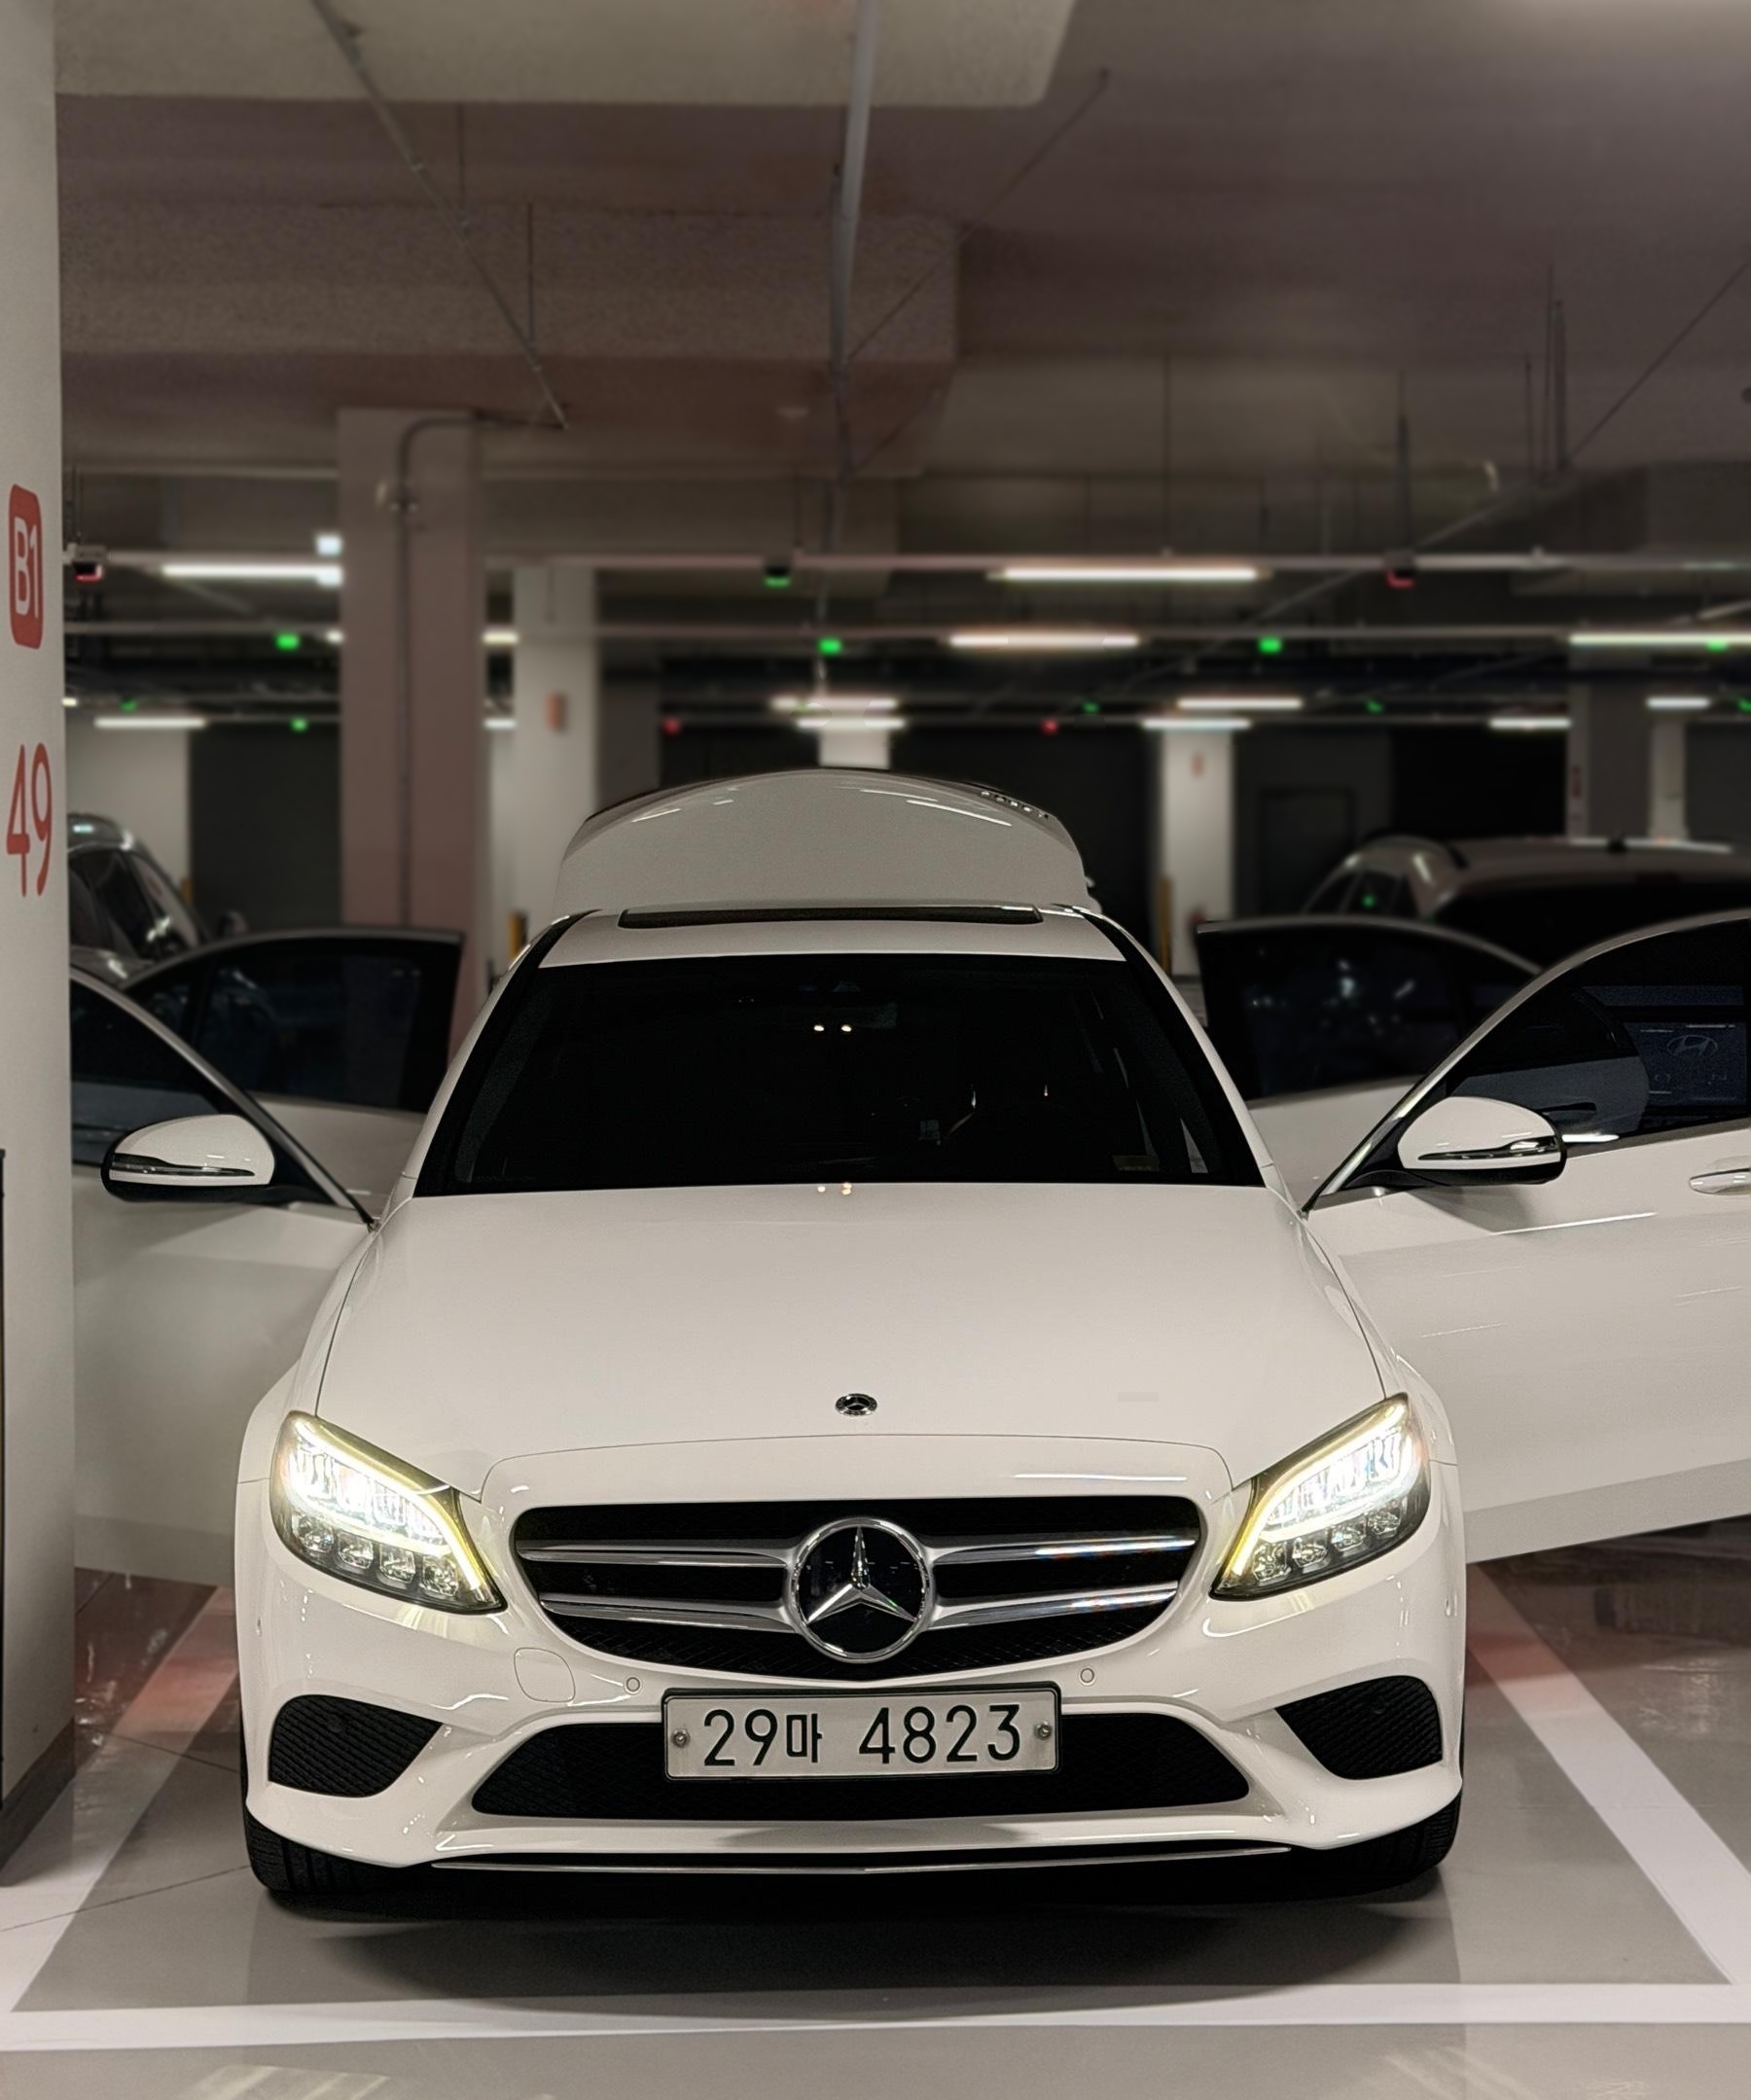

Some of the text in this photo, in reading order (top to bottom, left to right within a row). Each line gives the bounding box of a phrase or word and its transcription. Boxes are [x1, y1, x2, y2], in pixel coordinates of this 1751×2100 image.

[15, 516, 39, 619] B1
[6, 742, 53, 898] 49
[703, 1703, 1021, 1766] 29마 4823
